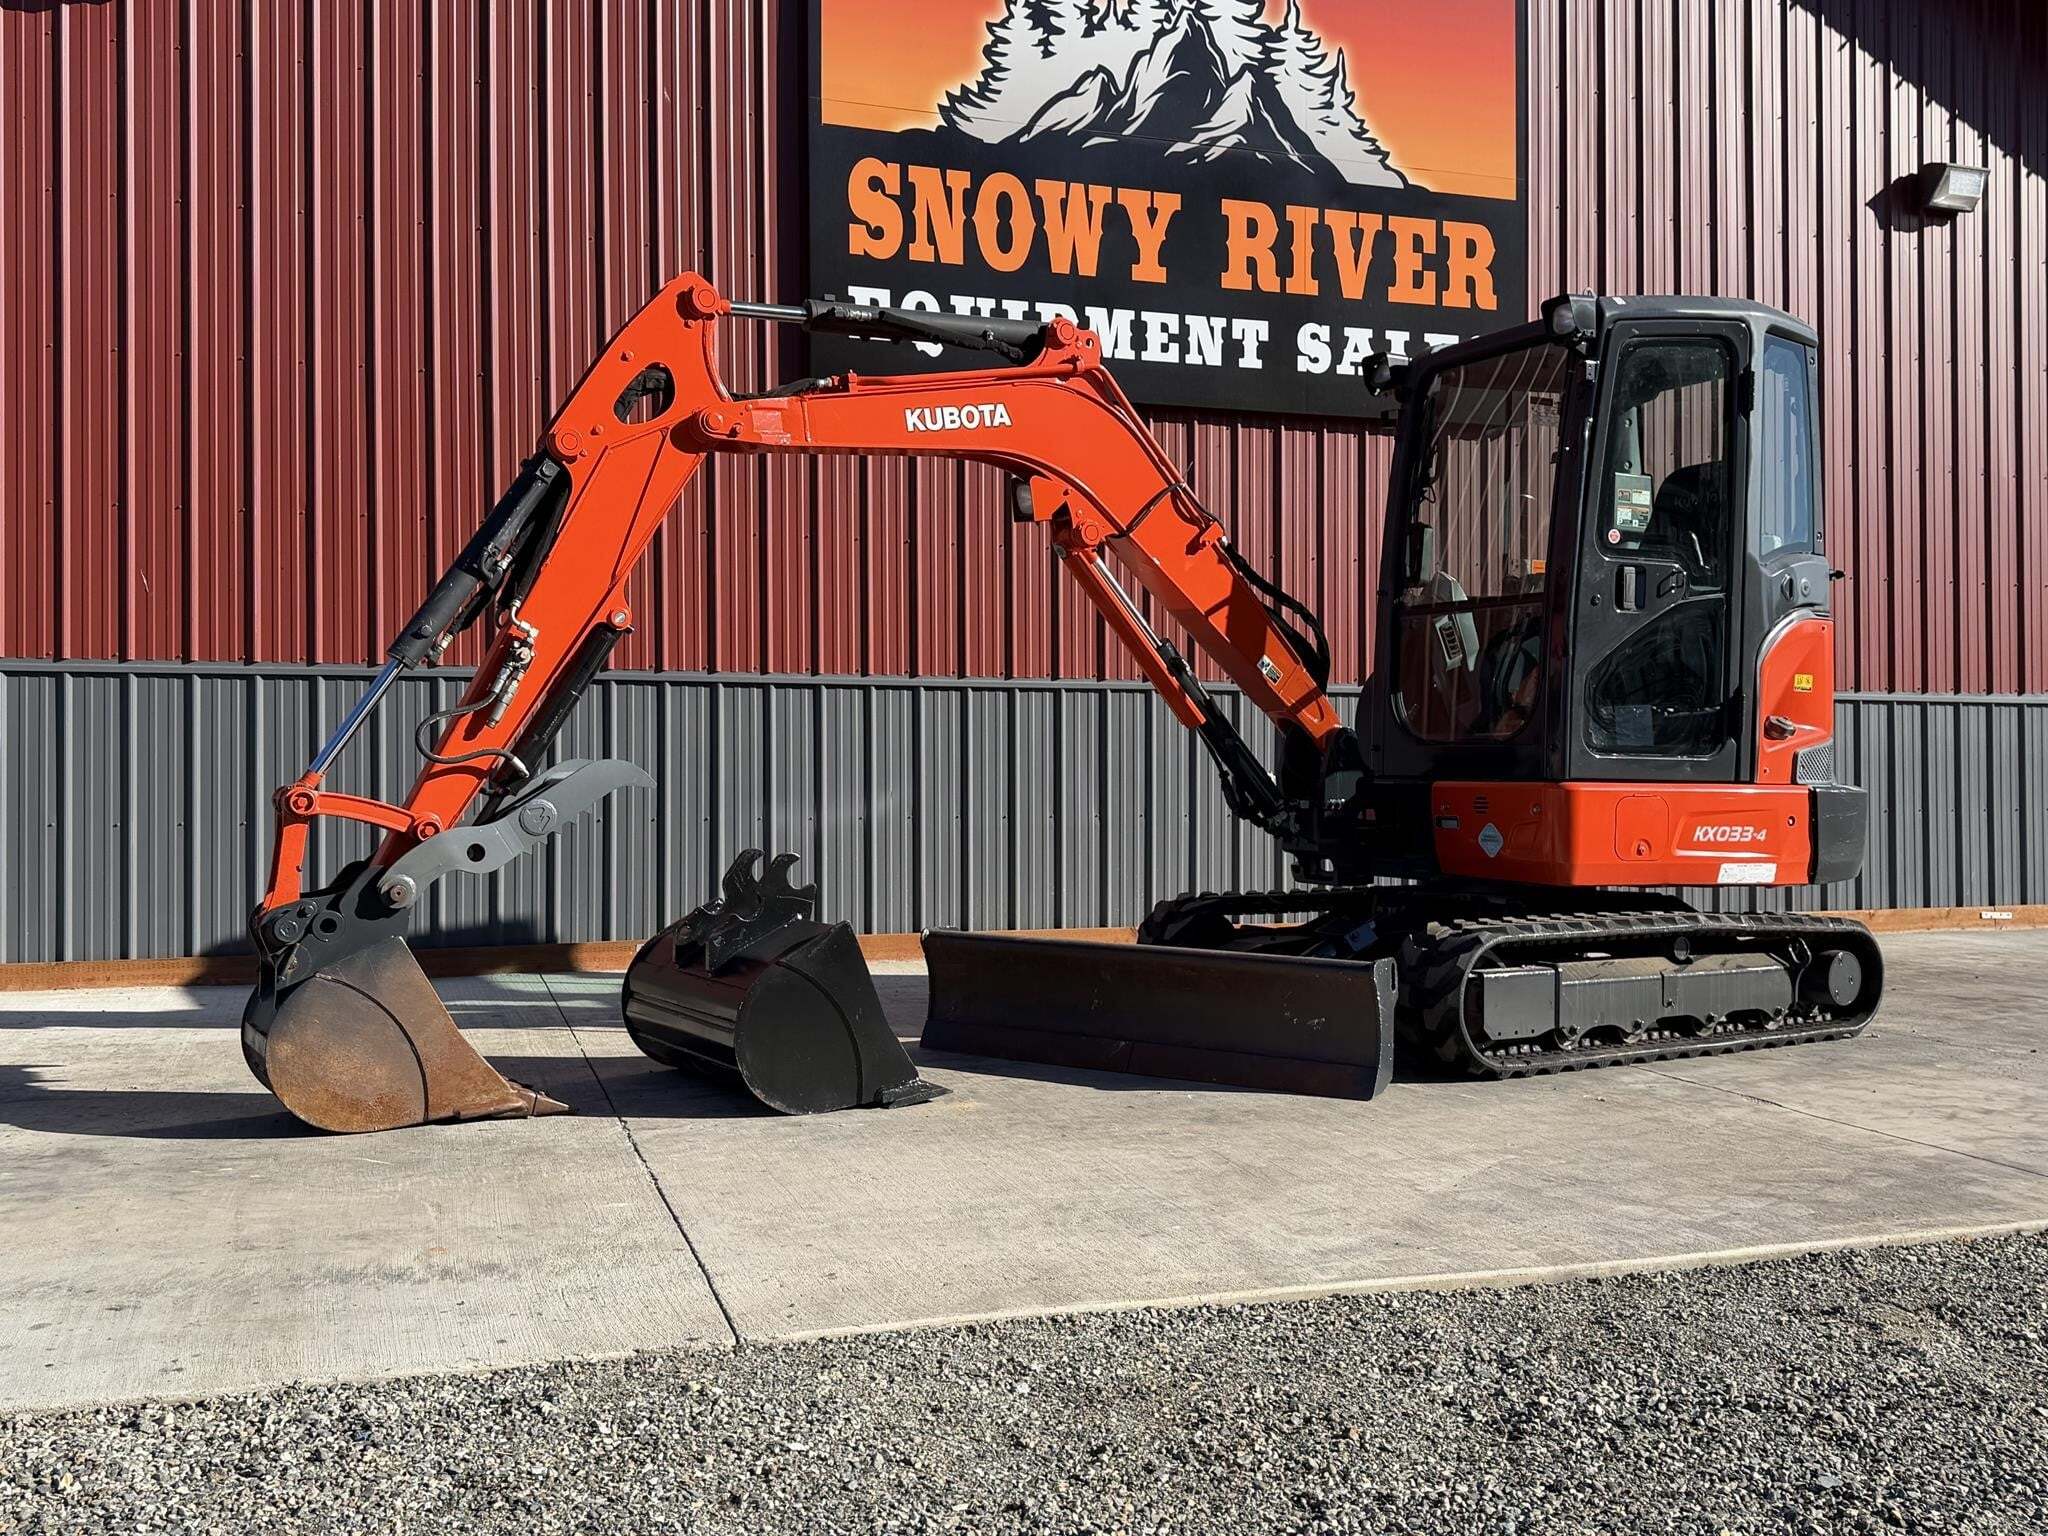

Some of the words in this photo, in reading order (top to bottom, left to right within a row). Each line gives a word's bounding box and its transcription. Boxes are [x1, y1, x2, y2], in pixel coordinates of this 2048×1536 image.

[848, 157, 1181, 283] SNOWY
[1221, 198, 1498, 310] RIVER
[1297, 322, 1480, 376] SAL
[904, 403, 1012, 432] KUBOTA
[1692, 825, 1768, 842] KX033-4
